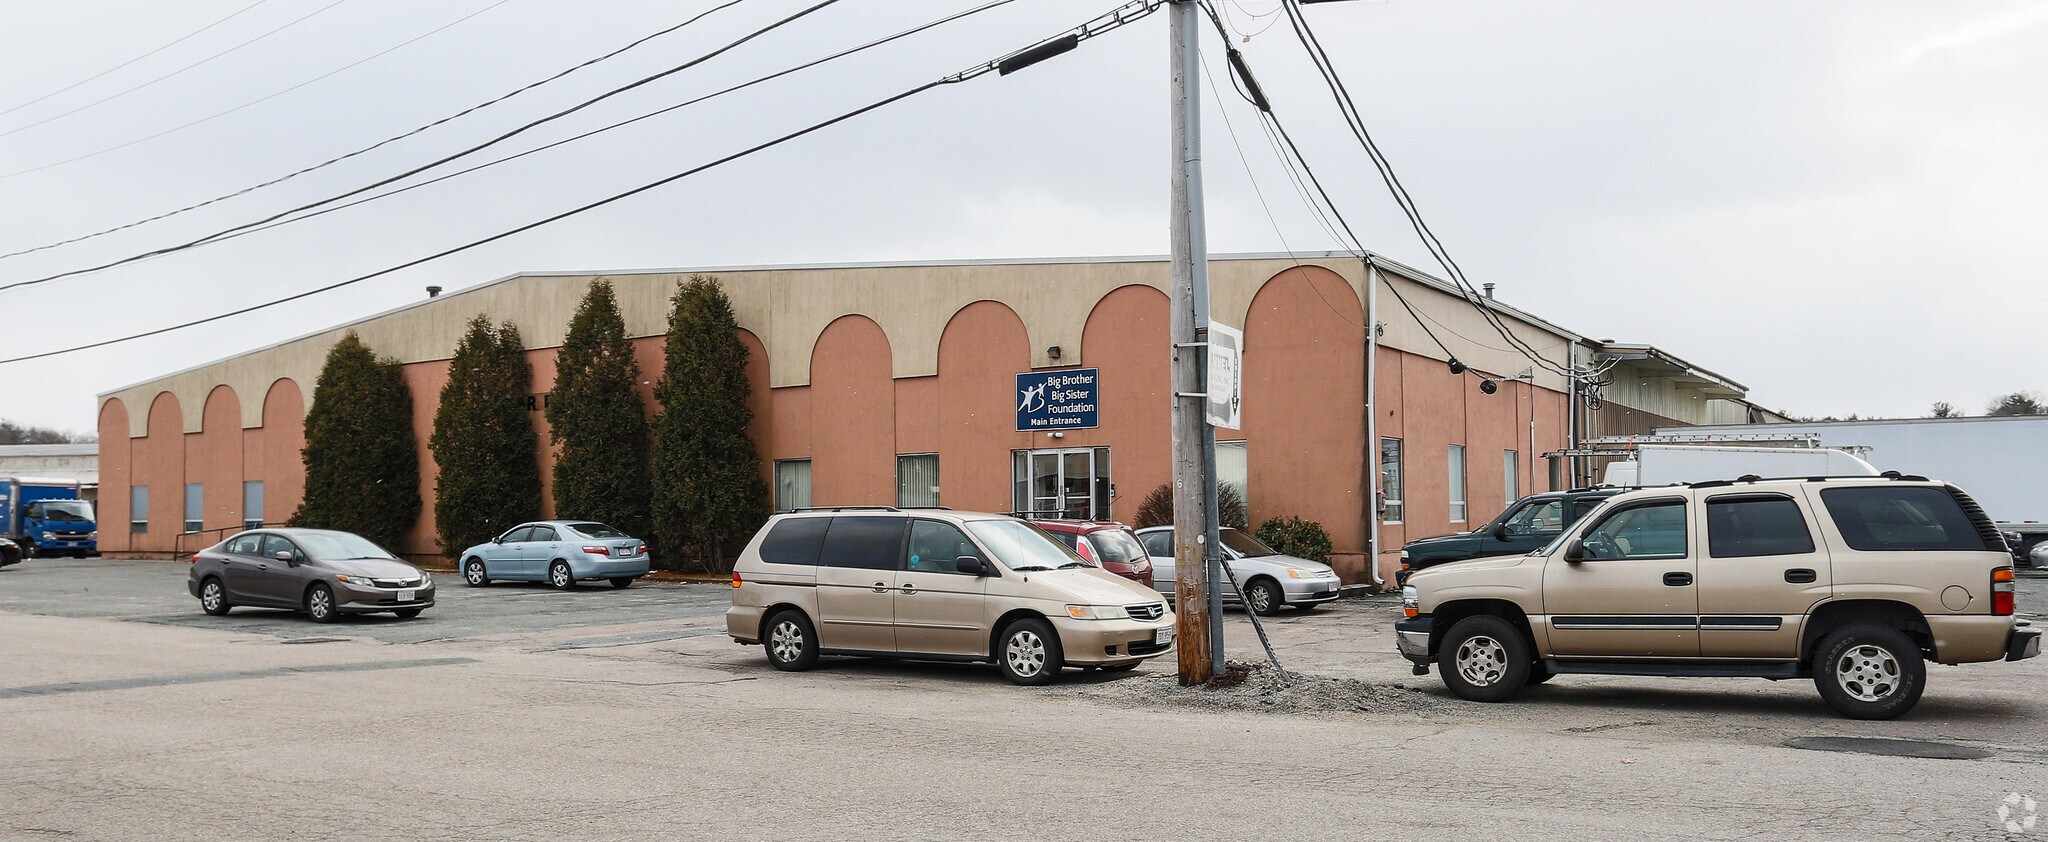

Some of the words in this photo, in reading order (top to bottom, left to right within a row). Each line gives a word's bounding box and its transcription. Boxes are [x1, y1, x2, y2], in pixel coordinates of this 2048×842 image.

[1047, 376, 1061, 389] Big
[1062, 373, 1094, 385] Brother
[1051, 390, 1065, 403] Big
[1065, 389, 1089, 400] Sister
[1048, 402, 1094, 414] Foundation
[1030, 418, 1047, 426] Main
[1049, 416, 1082, 426] Entrance
